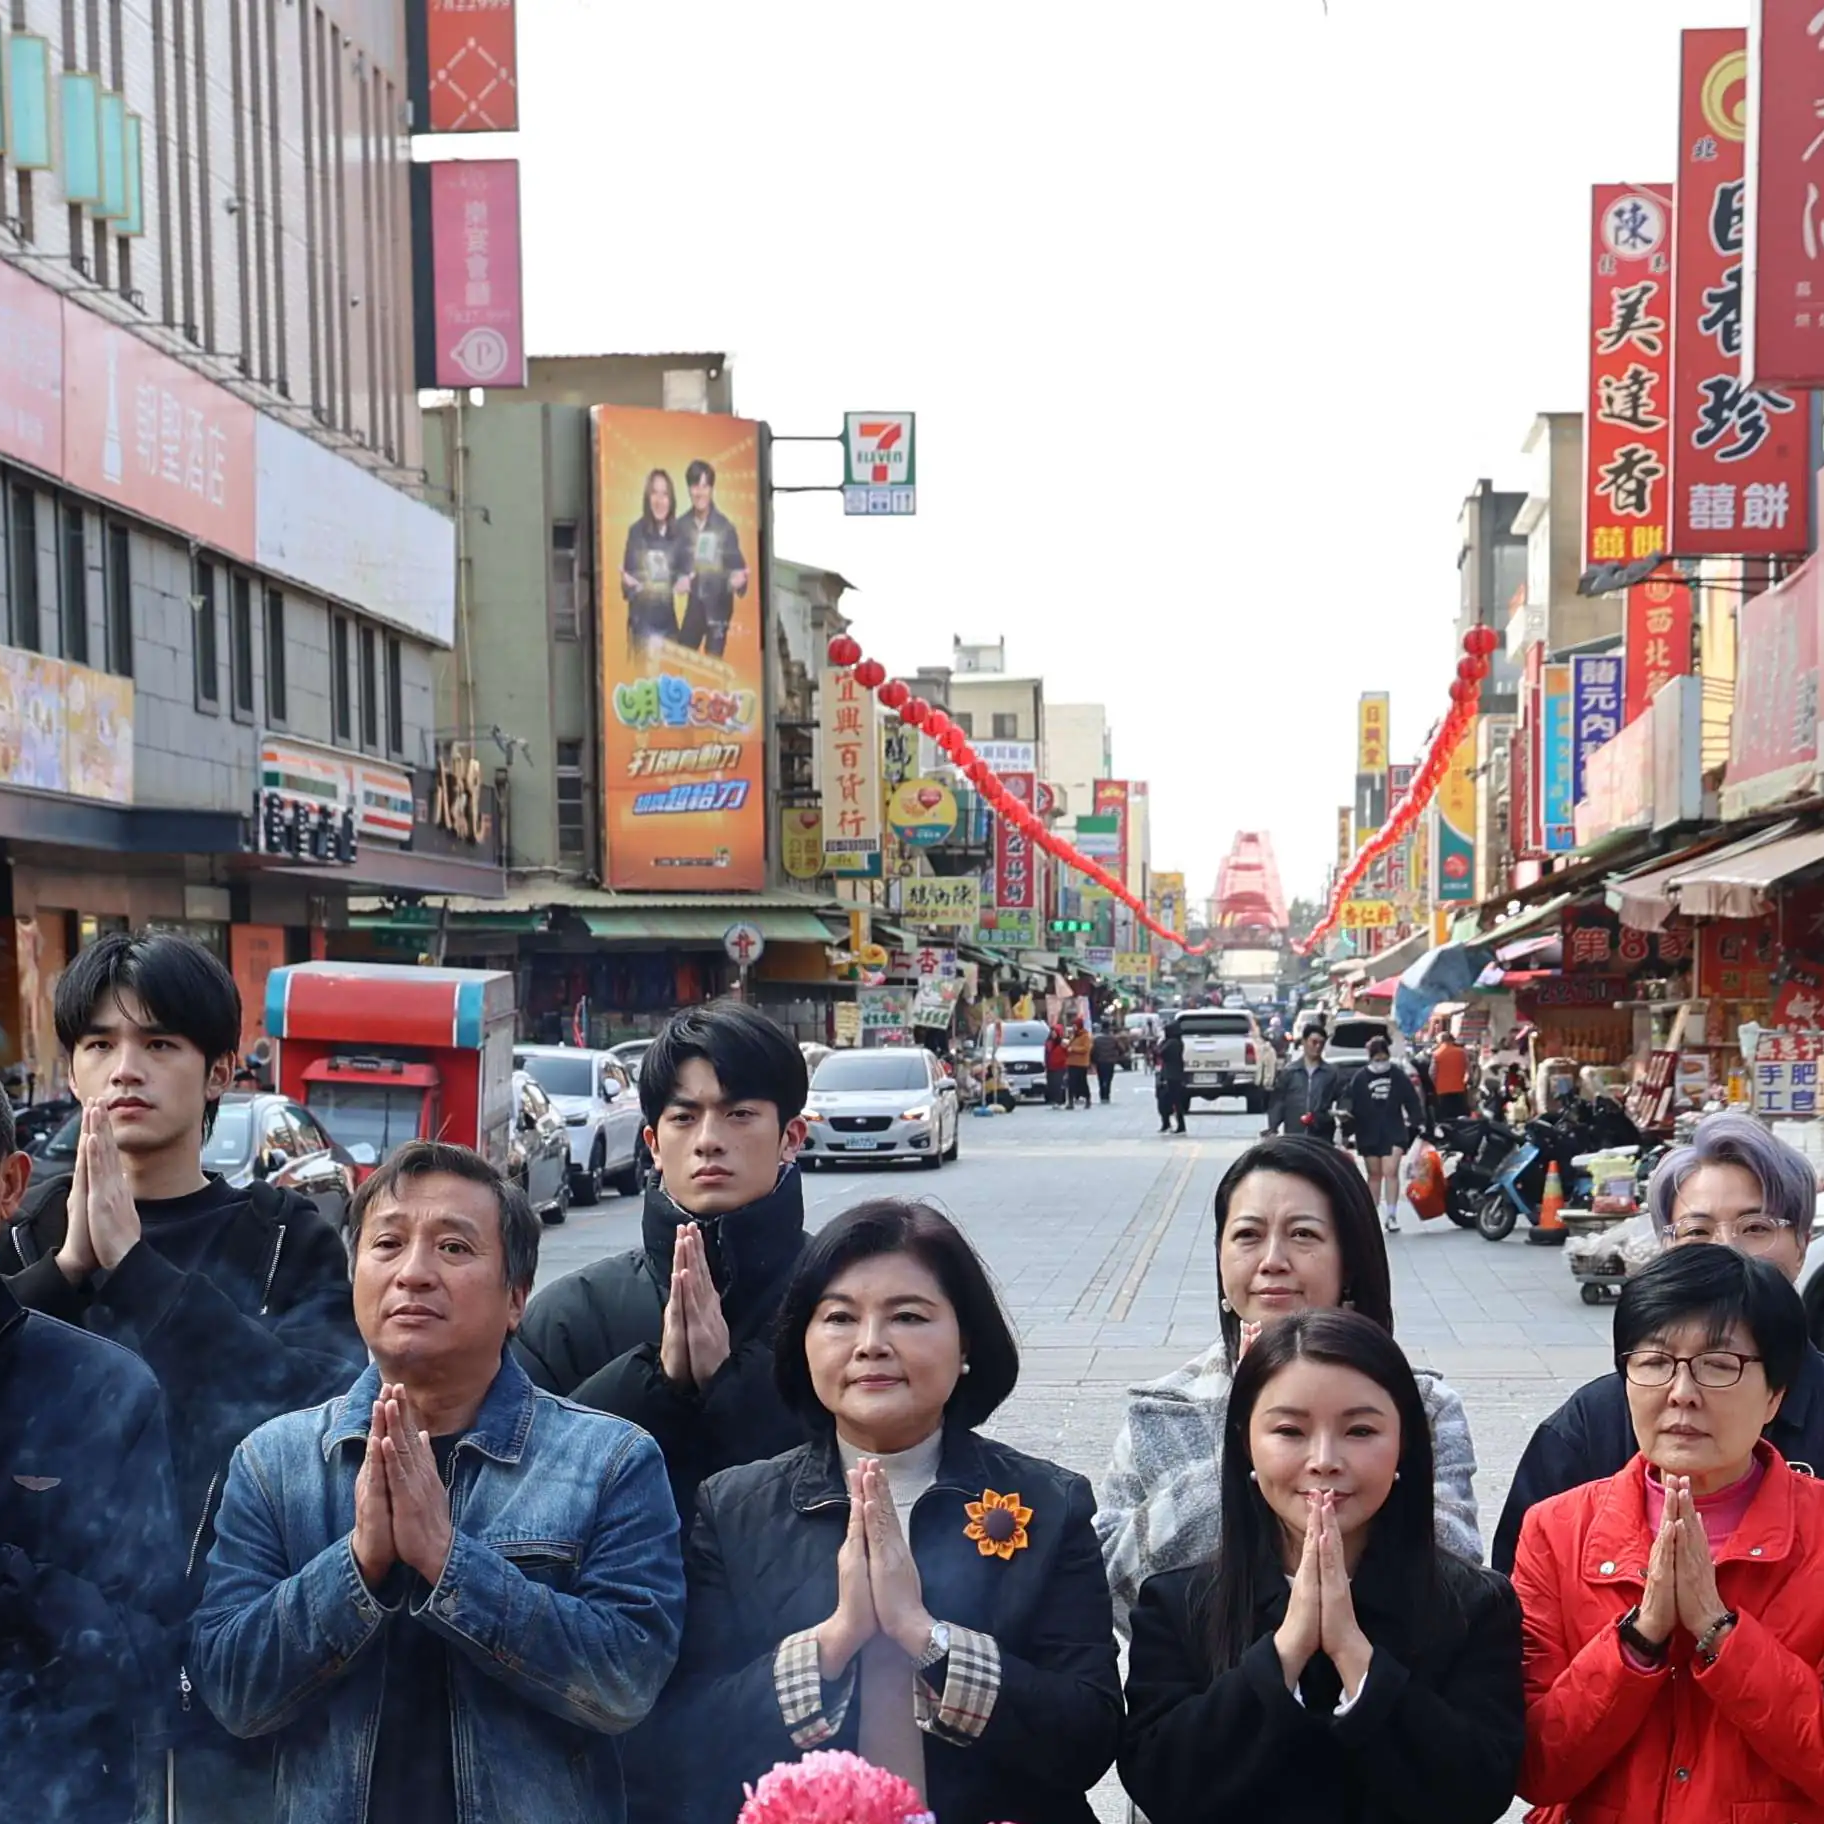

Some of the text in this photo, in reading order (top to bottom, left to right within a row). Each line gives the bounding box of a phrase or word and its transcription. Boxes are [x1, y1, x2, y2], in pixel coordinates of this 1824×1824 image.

[1595, 280, 1666, 517] 美達香
[1687, 480, 1790, 531] 囍餅
